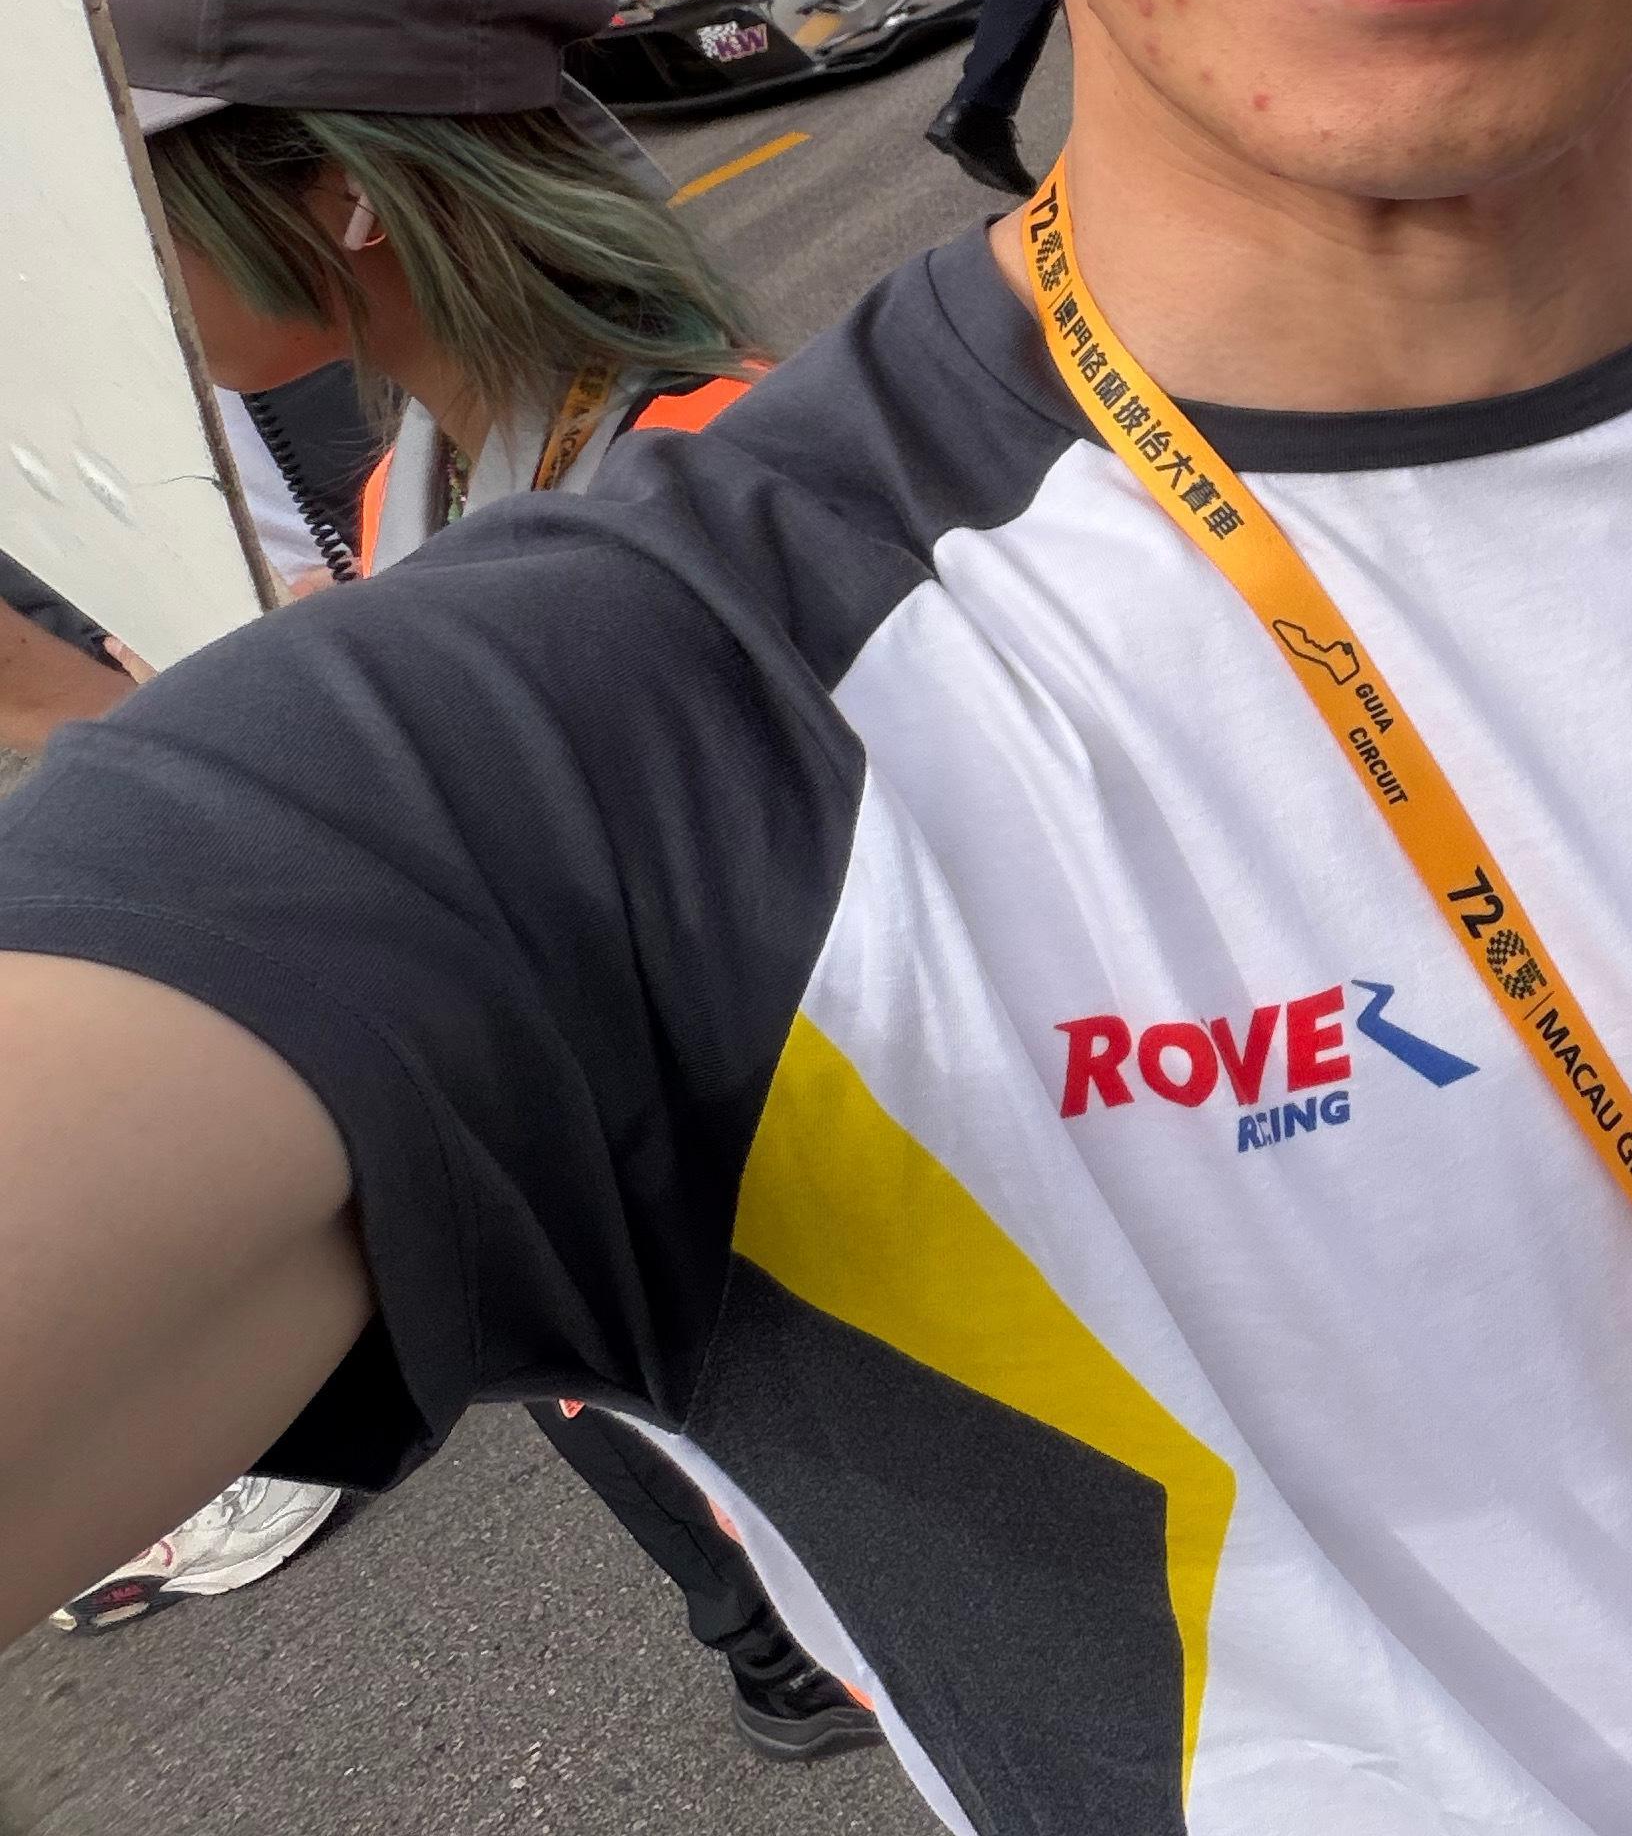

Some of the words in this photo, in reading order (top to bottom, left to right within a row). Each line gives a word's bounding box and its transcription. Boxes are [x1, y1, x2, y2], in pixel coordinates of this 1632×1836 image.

[714, 25, 768, 63] KW
[1029, 181, 1059, 244] 72
[1052, 292, 1245, 541] 澳門格蘭披治大賽車
[1355, 682, 1395, 735] GUIA
[1347, 726, 1409, 805] CIRCUIT
[1446, 864, 1505, 939] 72
[1536, 1006, 1623, 1132] MACAU
